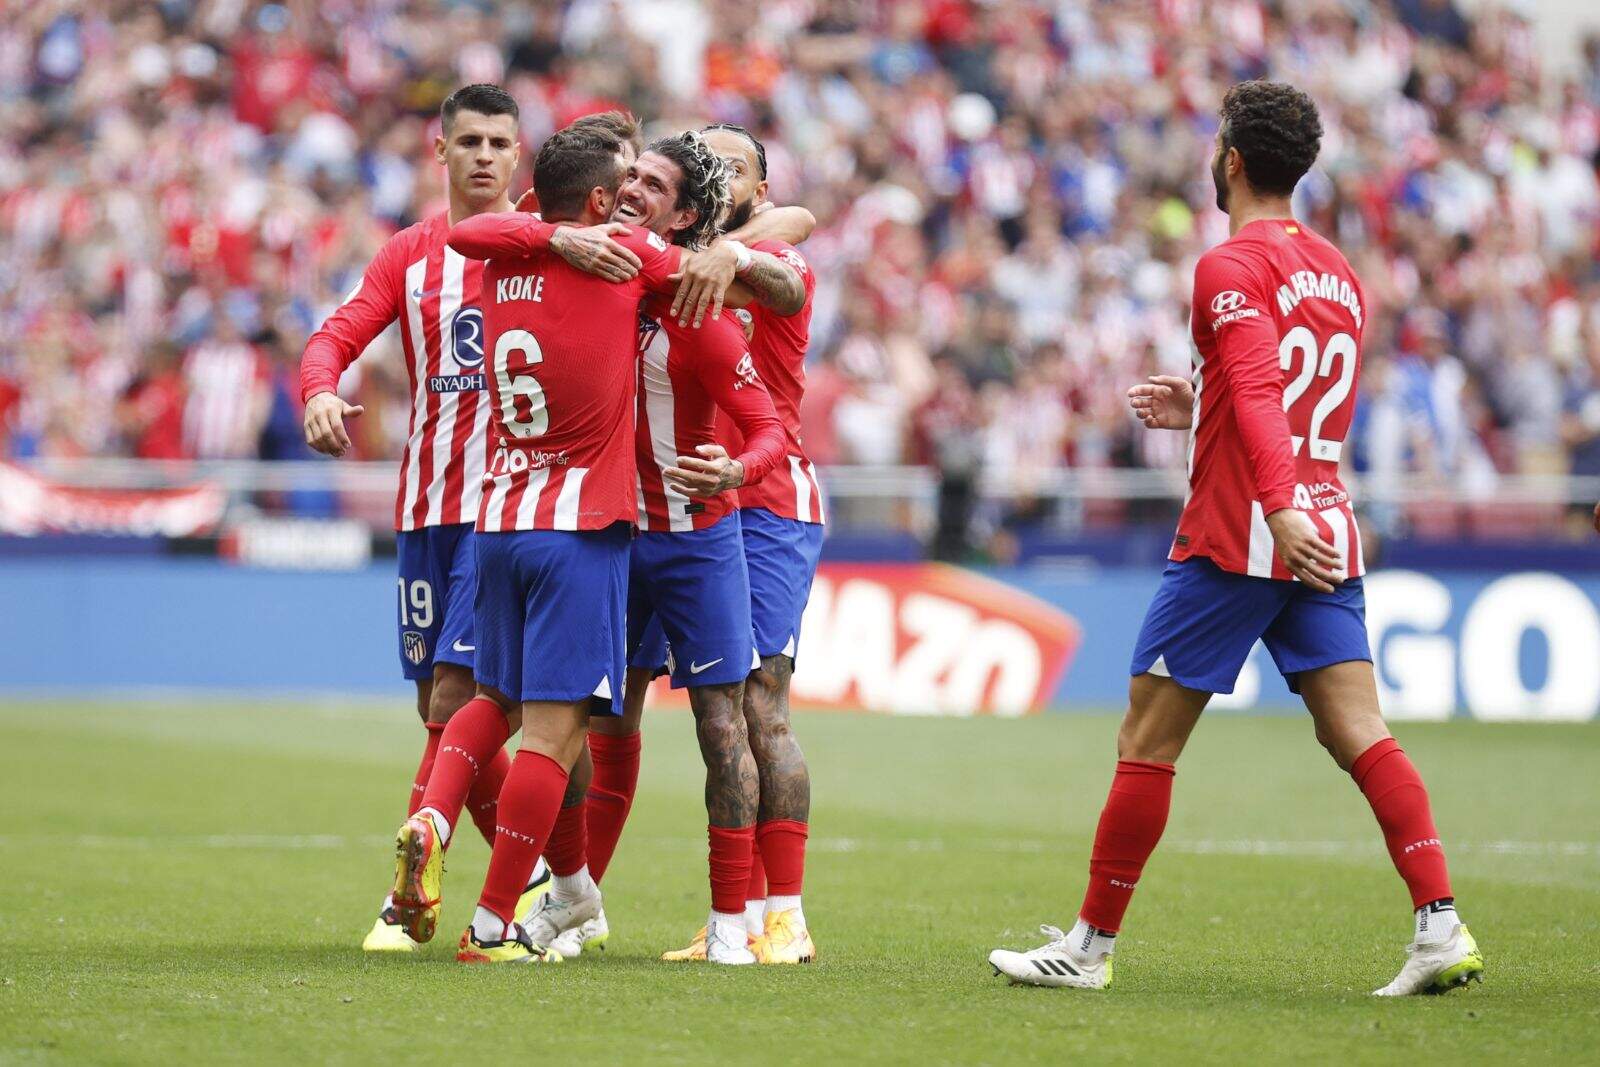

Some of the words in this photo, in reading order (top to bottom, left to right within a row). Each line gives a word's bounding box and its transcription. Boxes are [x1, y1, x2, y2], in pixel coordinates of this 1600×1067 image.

[497, 275, 544, 304] KOKE
[430, 375, 483, 392] RIYADH
[494, 329, 550, 438] 6
[1279, 325, 1357, 463] 22
[398, 577, 434, 628] 19
